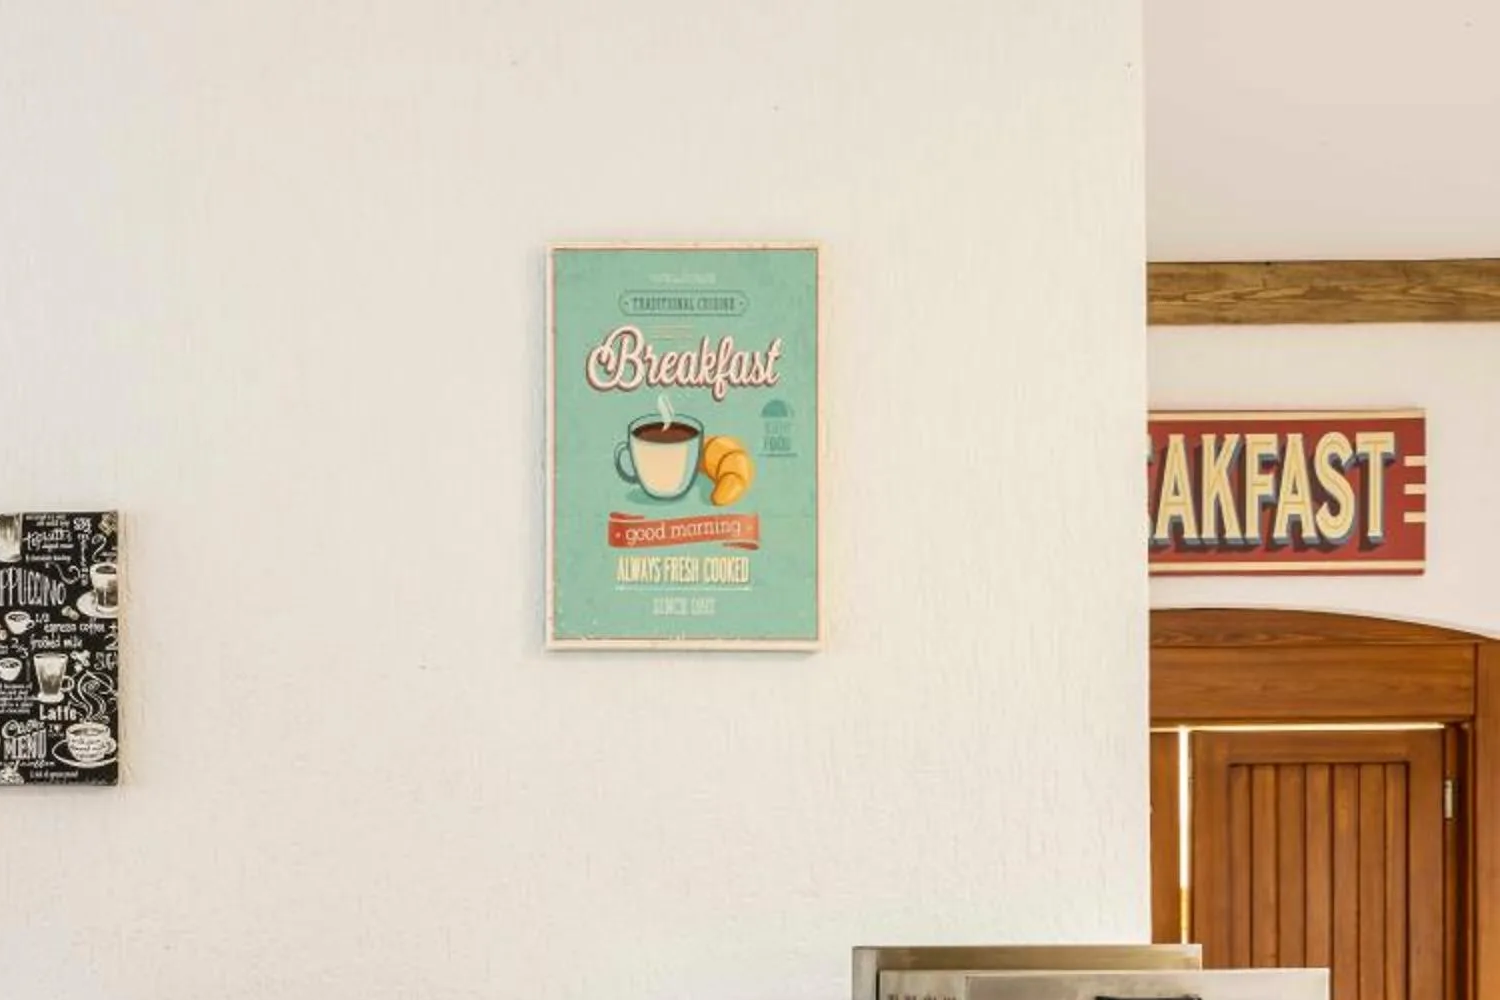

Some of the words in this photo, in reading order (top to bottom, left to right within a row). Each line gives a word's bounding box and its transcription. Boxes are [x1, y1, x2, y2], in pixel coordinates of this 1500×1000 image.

[585, 325, 783, 402] Breakfast
[1148, 431, 1396, 546] AKFAST
[625, 522, 666, 546] good
[671, 518, 742, 538] morning
[617, 556, 661, 582] ALWAYS
[663, 556, 700, 582] FRESH
[702, 556, 750, 582] COOKED
[39, 704, 77, 721] Latte
[3, 729, 48, 760] MENU
